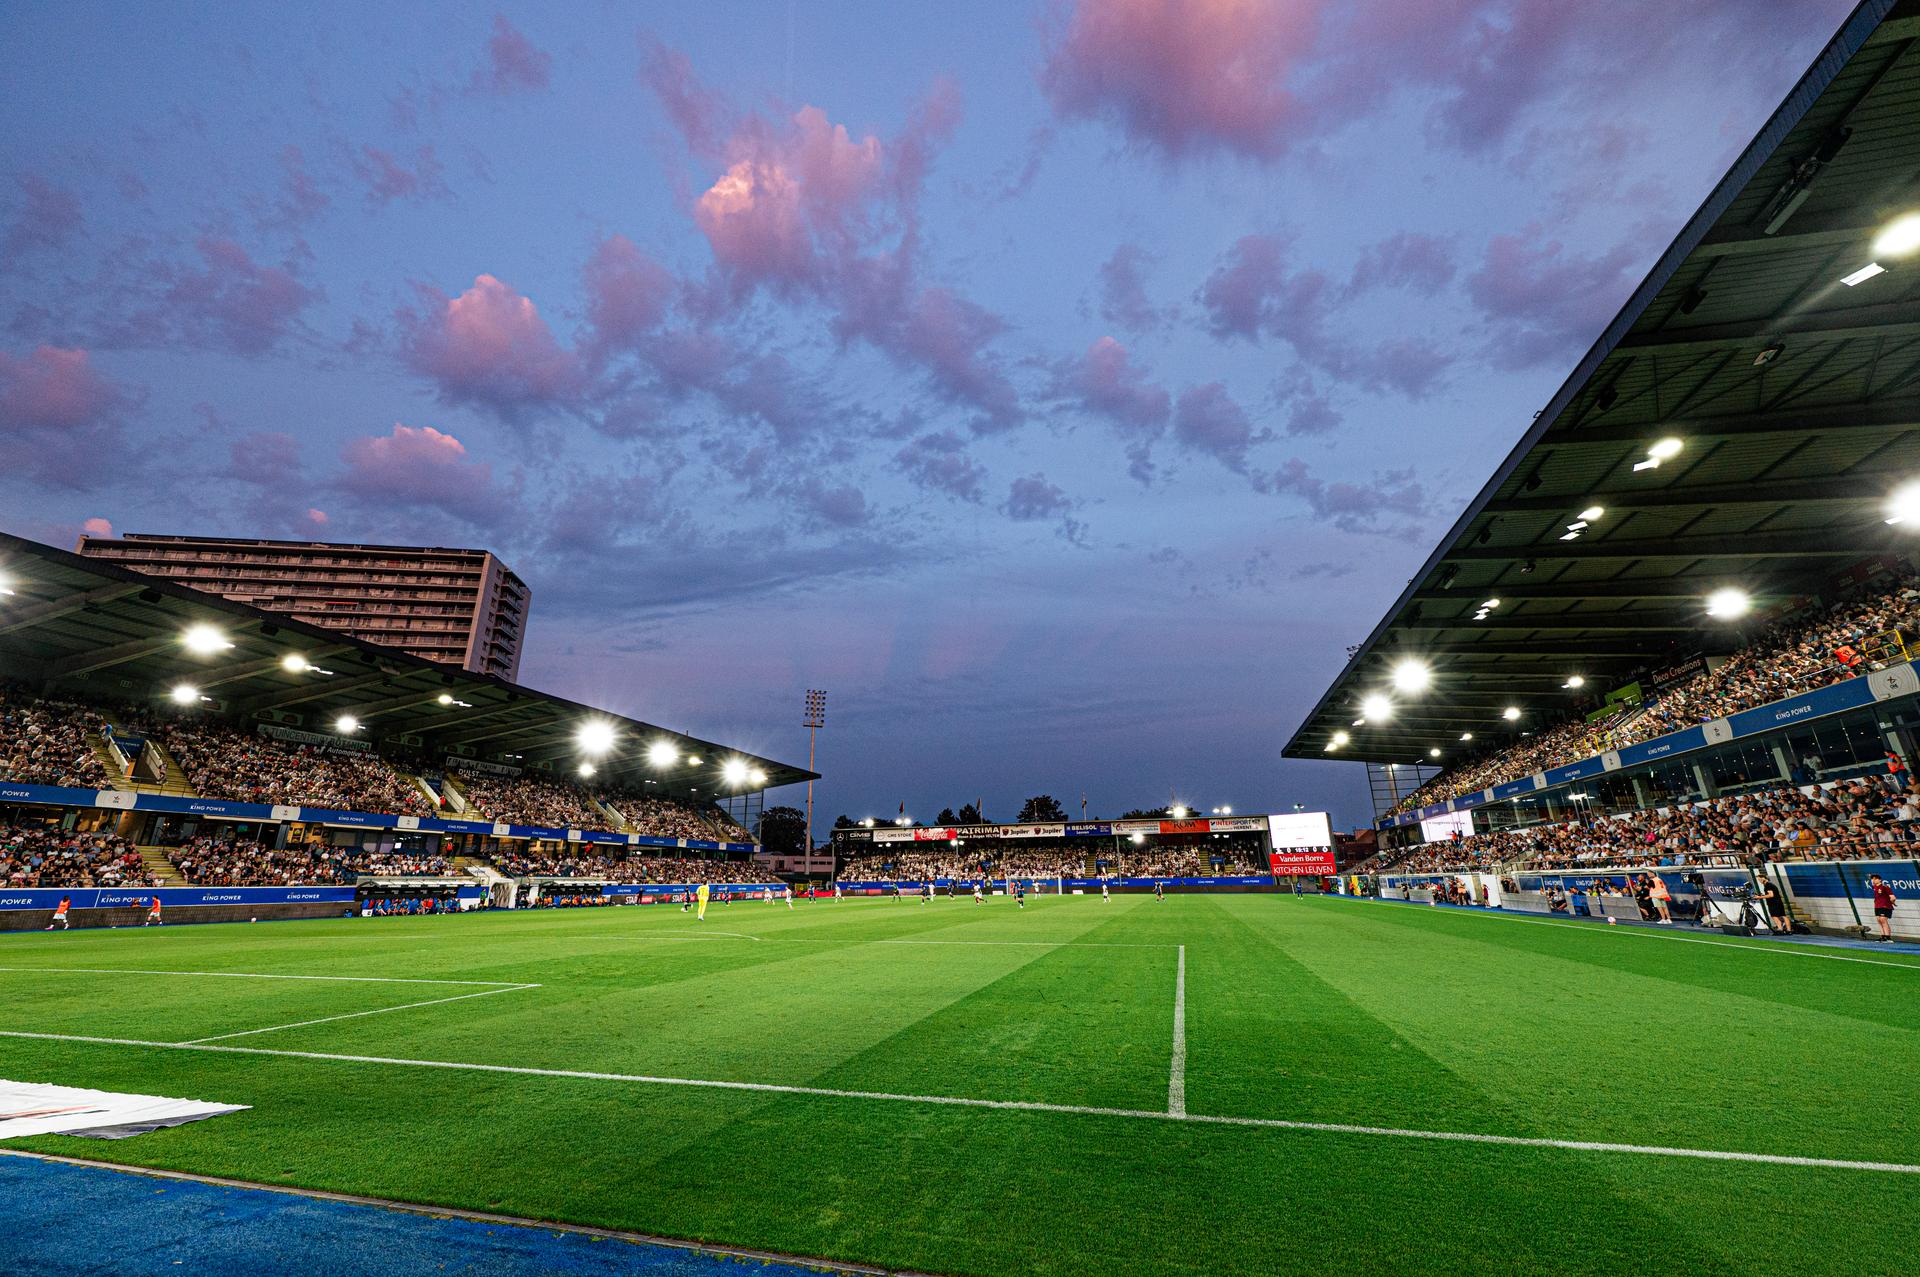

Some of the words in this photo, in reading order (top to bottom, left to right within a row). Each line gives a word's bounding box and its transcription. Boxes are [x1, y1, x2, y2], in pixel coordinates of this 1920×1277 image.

[1669, 658, 1702, 677] Creations
[1775, 711, 1791, 721] KING
[1790, 705, 1812, 716] POWER
[1, 790, 30, 798] POWER
[1215, 819, 1251, 827] INTERSPORT
[957, 826, 1000, 834] PATRIMA
[1279, 855, 1304, 863] Vanden
[1273, 866, 1304, 875] KITCHEN
[1305, 866, 1334, 875] LEUVEN
[1707, 885, 1725, 894] KING
